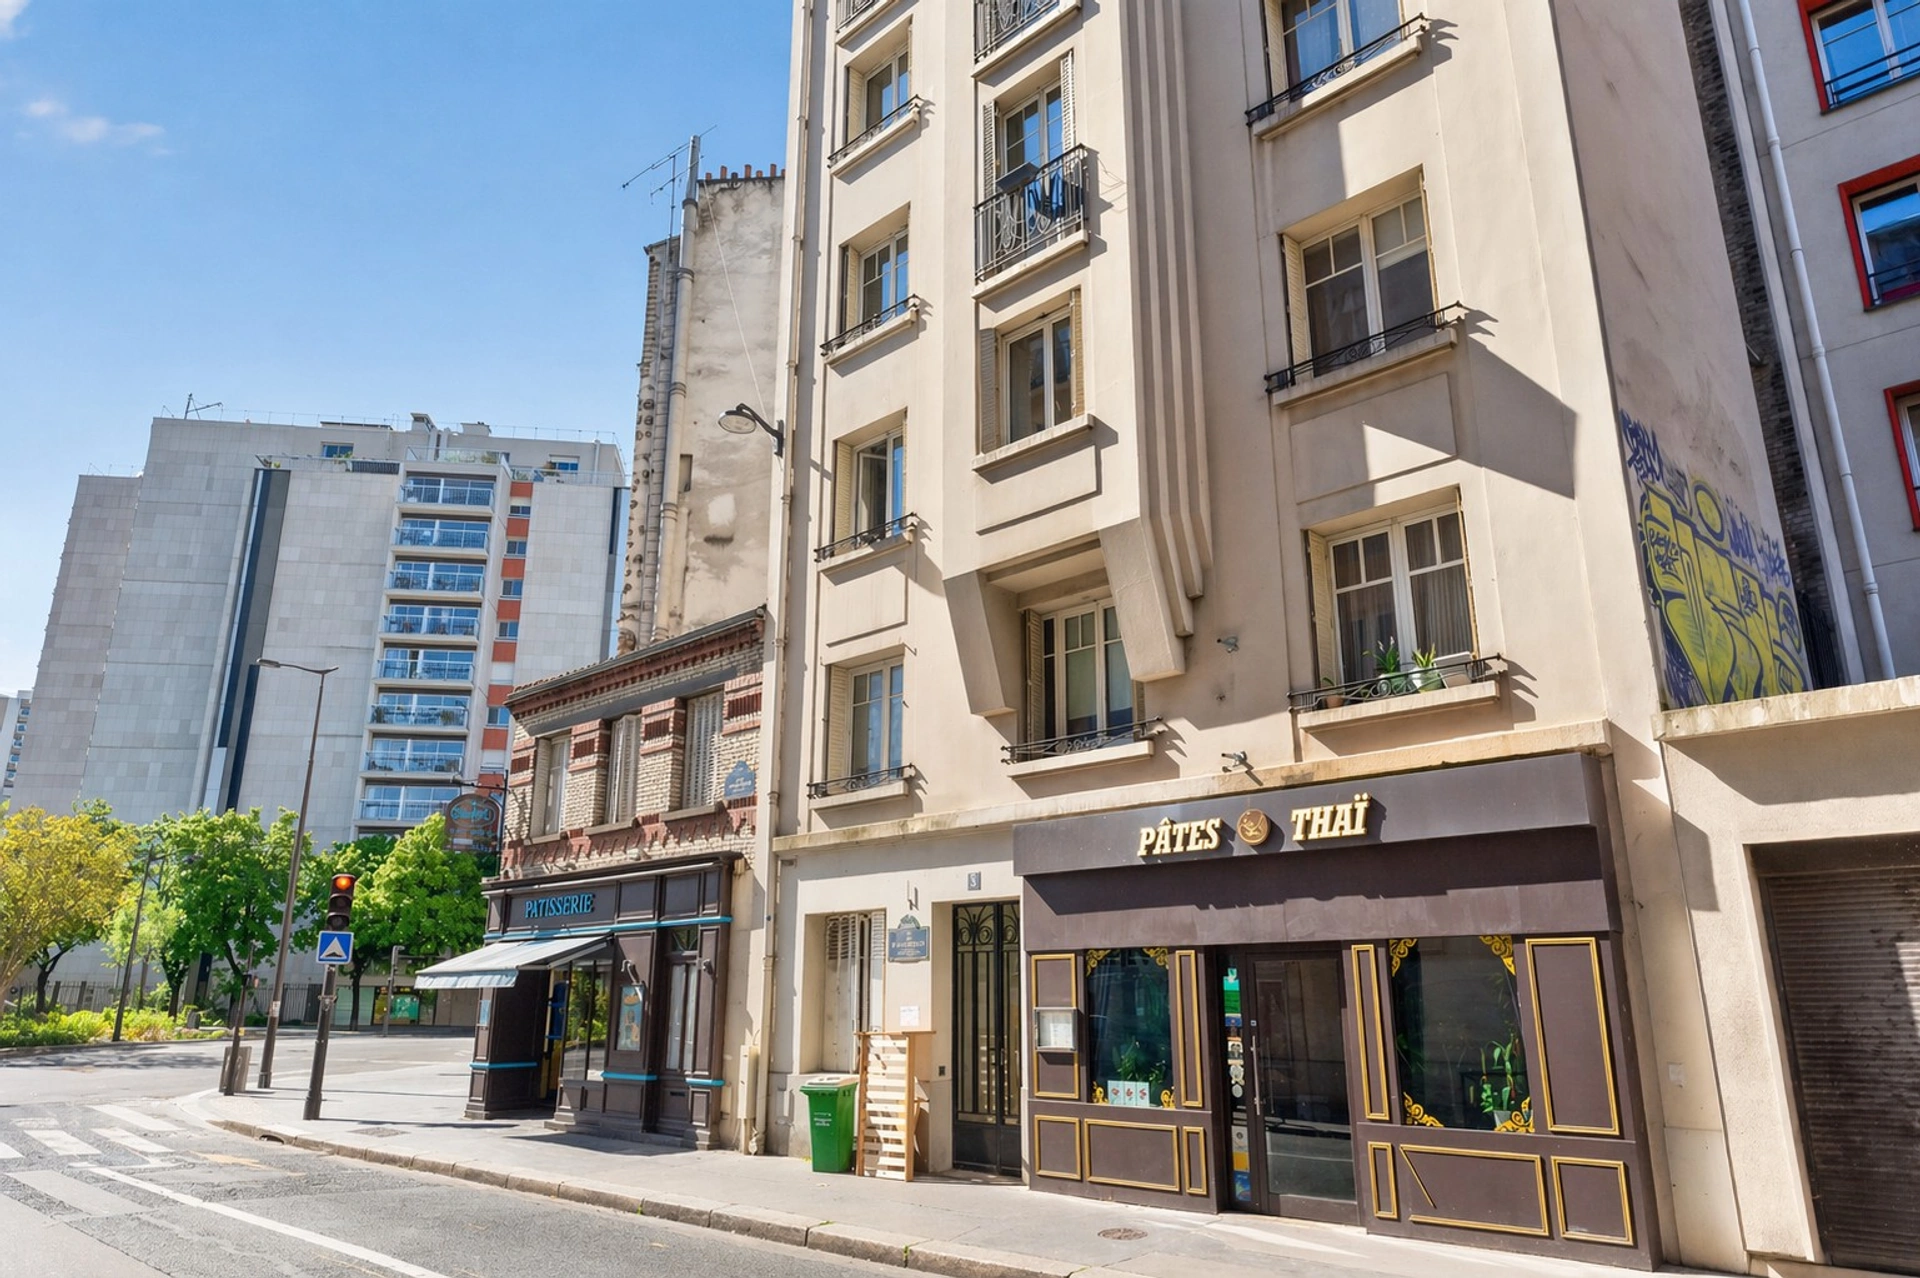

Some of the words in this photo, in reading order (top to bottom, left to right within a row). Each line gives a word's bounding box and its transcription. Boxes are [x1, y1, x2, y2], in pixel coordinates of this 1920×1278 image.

[1137, 816, 1222, 857] PÂTES
[1291, 792, 1370, 841] THAÏ
[525, 893, 594, 918] PATISSERIE
